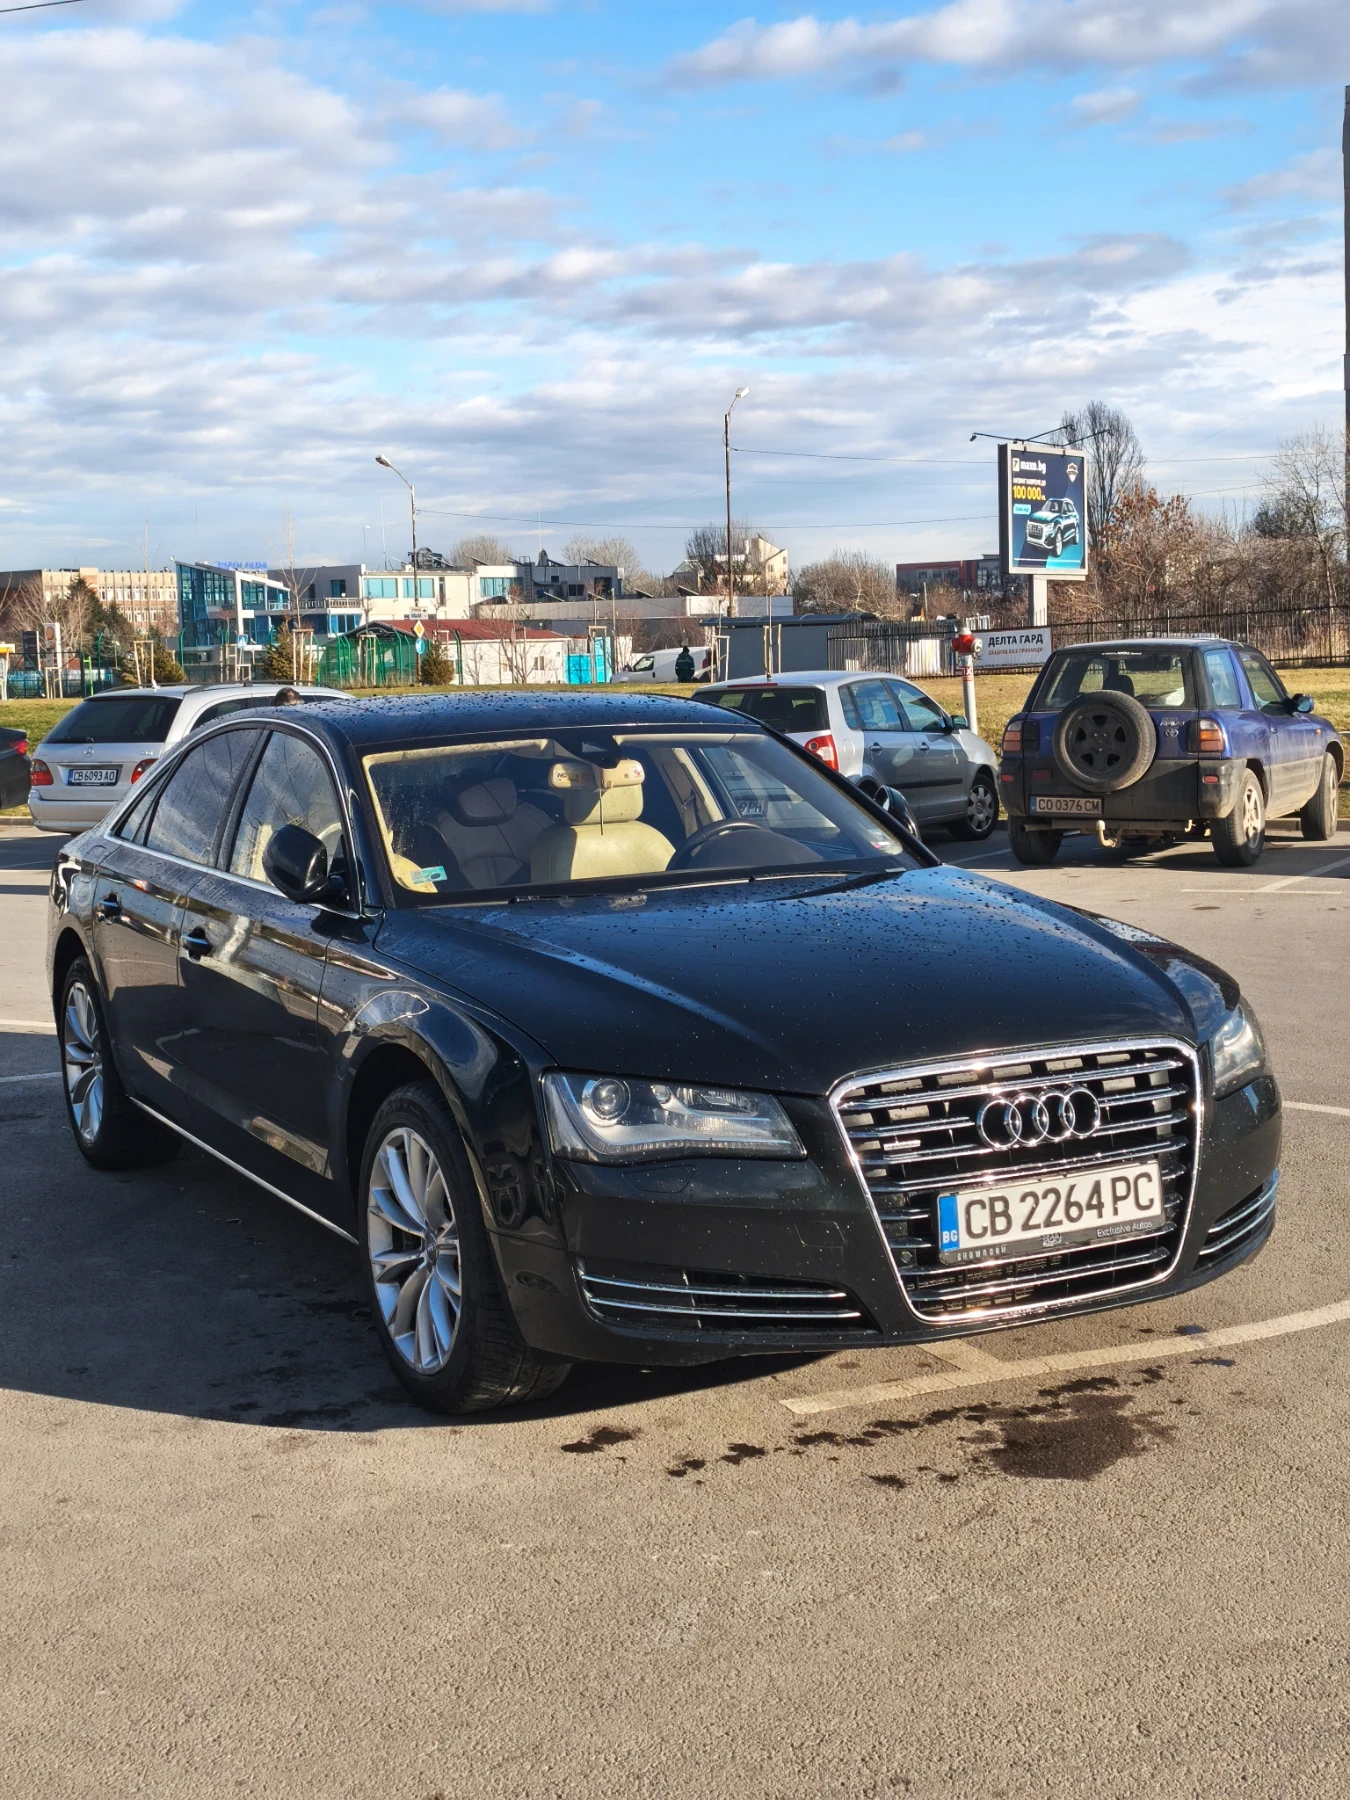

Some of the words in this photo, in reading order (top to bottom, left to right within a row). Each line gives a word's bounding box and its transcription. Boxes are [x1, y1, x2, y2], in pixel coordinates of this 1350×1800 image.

[1013, 485, 1026, 499] 100
[1027, 486, 1041, 500] 000
[988, 635, 1017, 647] ДЕЛТА
[1020, 634, 1043, 644] ГАРД
[73, 770, 83, 782] CB
[84, 770, 102, 782] 6093
[1055, 799, 1082, 811] 0376
[1084, 800, 1099, 812] CM
[965, 1195, 1013, 1240] CB
[1019, 1179, 1104, 1232] 2264
[1111, 1172, 1154, 1217] PC
[942, 1229, 958, 1244] BG
[1097, 1224, 1131, 1238] Exclusive
[1132, 1220, 1153, 1231] Autos
